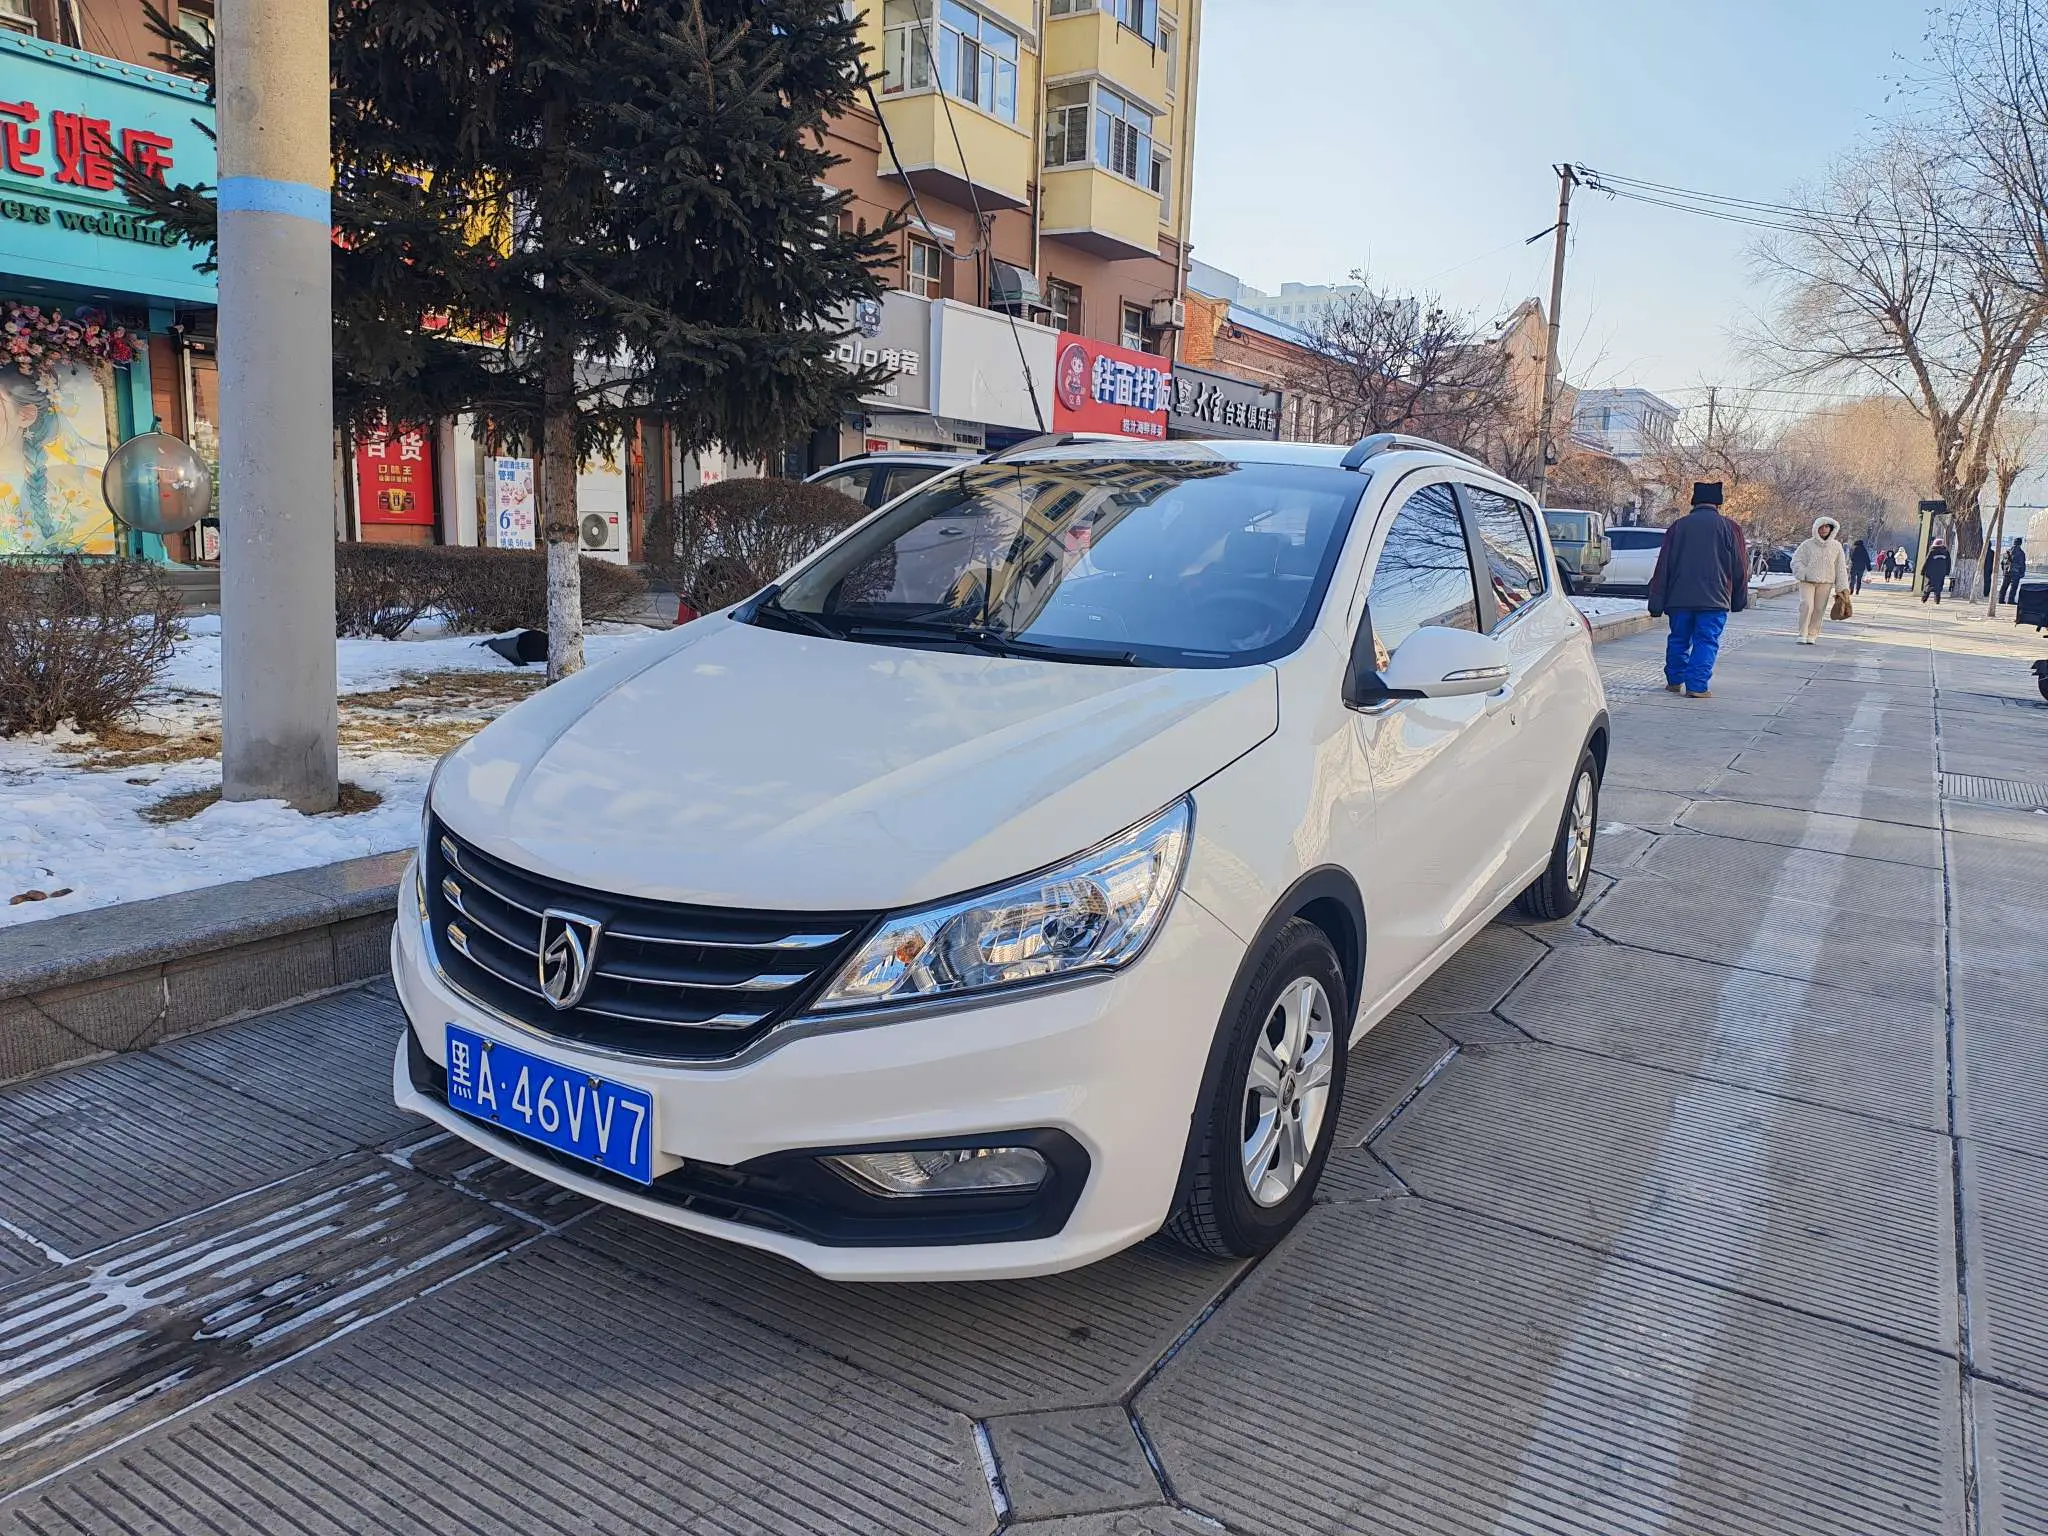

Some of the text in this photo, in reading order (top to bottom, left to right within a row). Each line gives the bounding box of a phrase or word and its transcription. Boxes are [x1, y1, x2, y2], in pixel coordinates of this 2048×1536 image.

[0, 198, 51, 225] ers
[1092, 354, 1172, 414] 拌面拌饭
[451, 1039, 645, 1166] 黑A·46VV7
